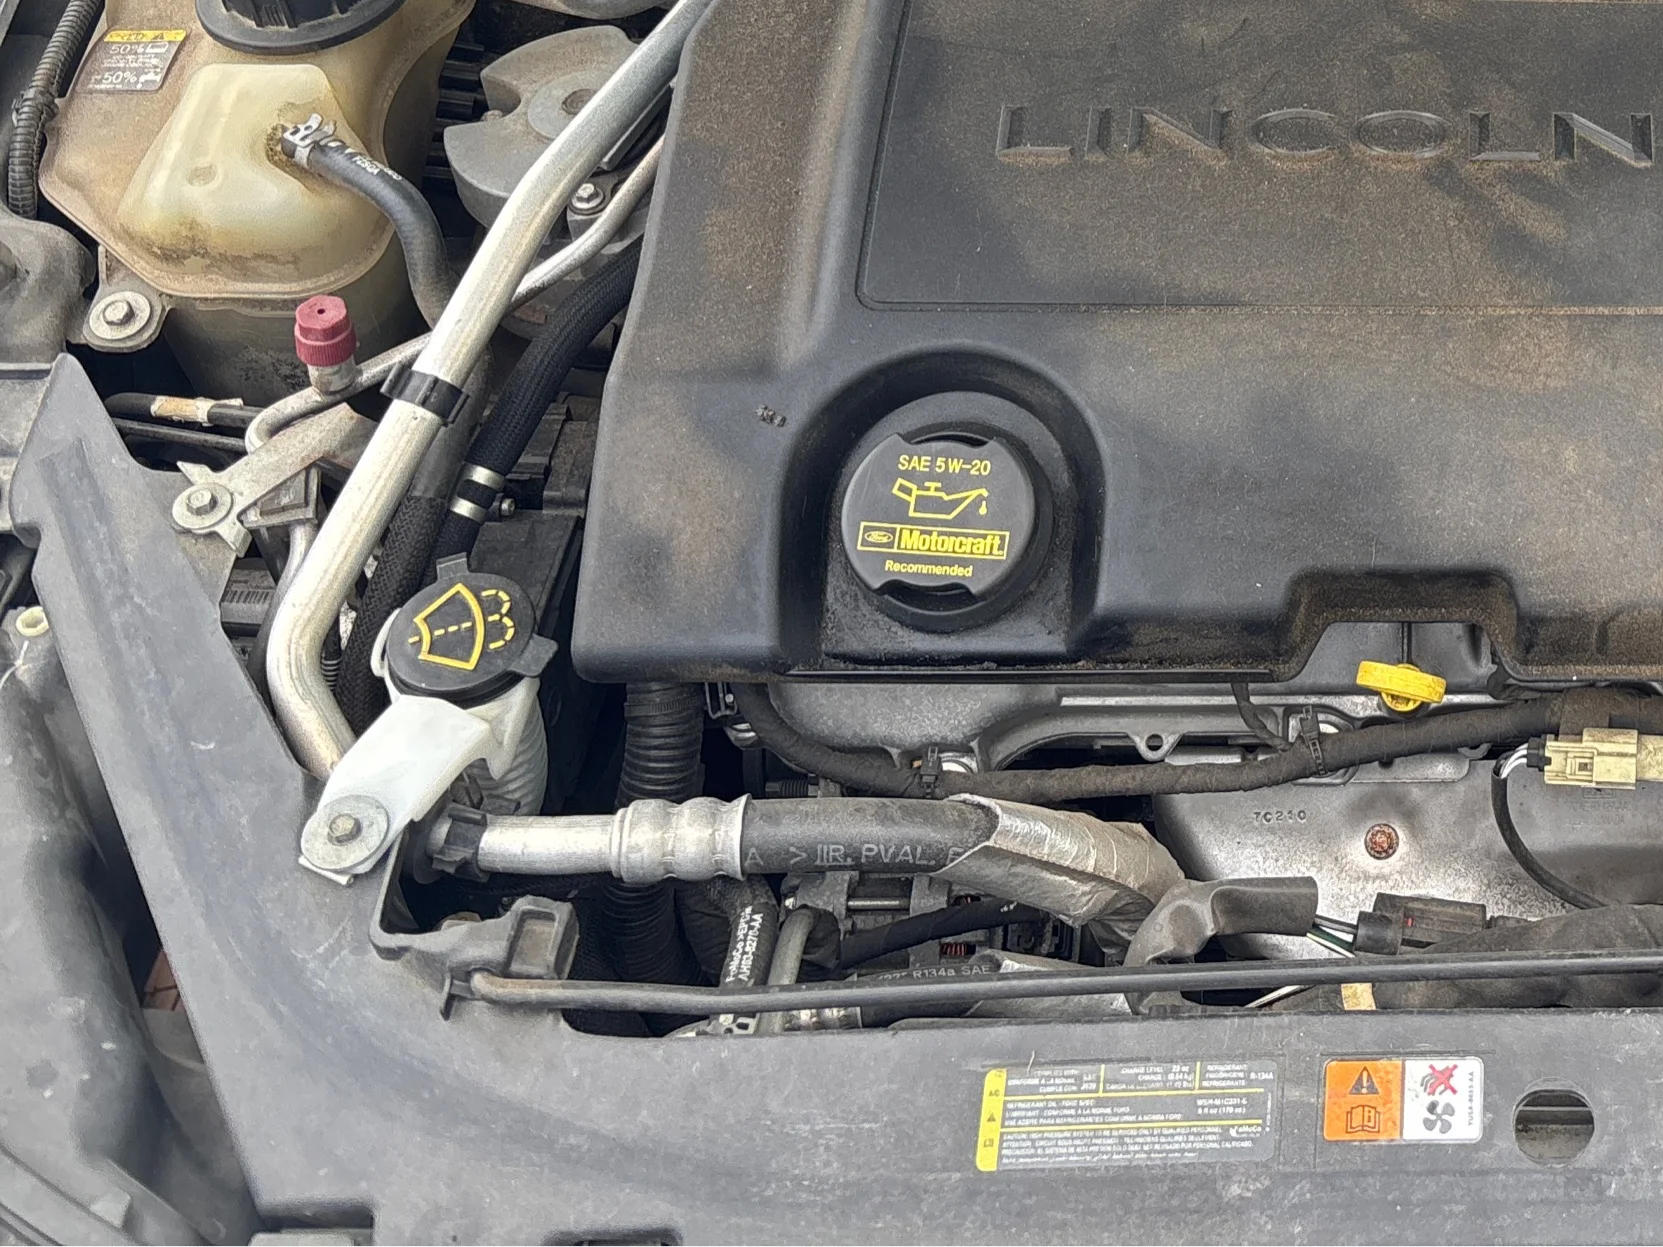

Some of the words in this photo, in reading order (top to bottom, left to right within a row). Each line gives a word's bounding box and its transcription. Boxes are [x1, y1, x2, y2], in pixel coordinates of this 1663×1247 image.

[110, 43, 145, 55] 50%
[102, 70, 138, 83] 50%
[995, 105, 1654, 167] LINCOLN
[898, 454, 931, 472] SAE
[935, 456, 991, 476] 5W-20
[900, 528, 1004, 556] Motorcraft
[885, 559, 974, 577] Recommended
[912, 966, 957, 979] R134a
[960, 964, 991, 976] SAE
